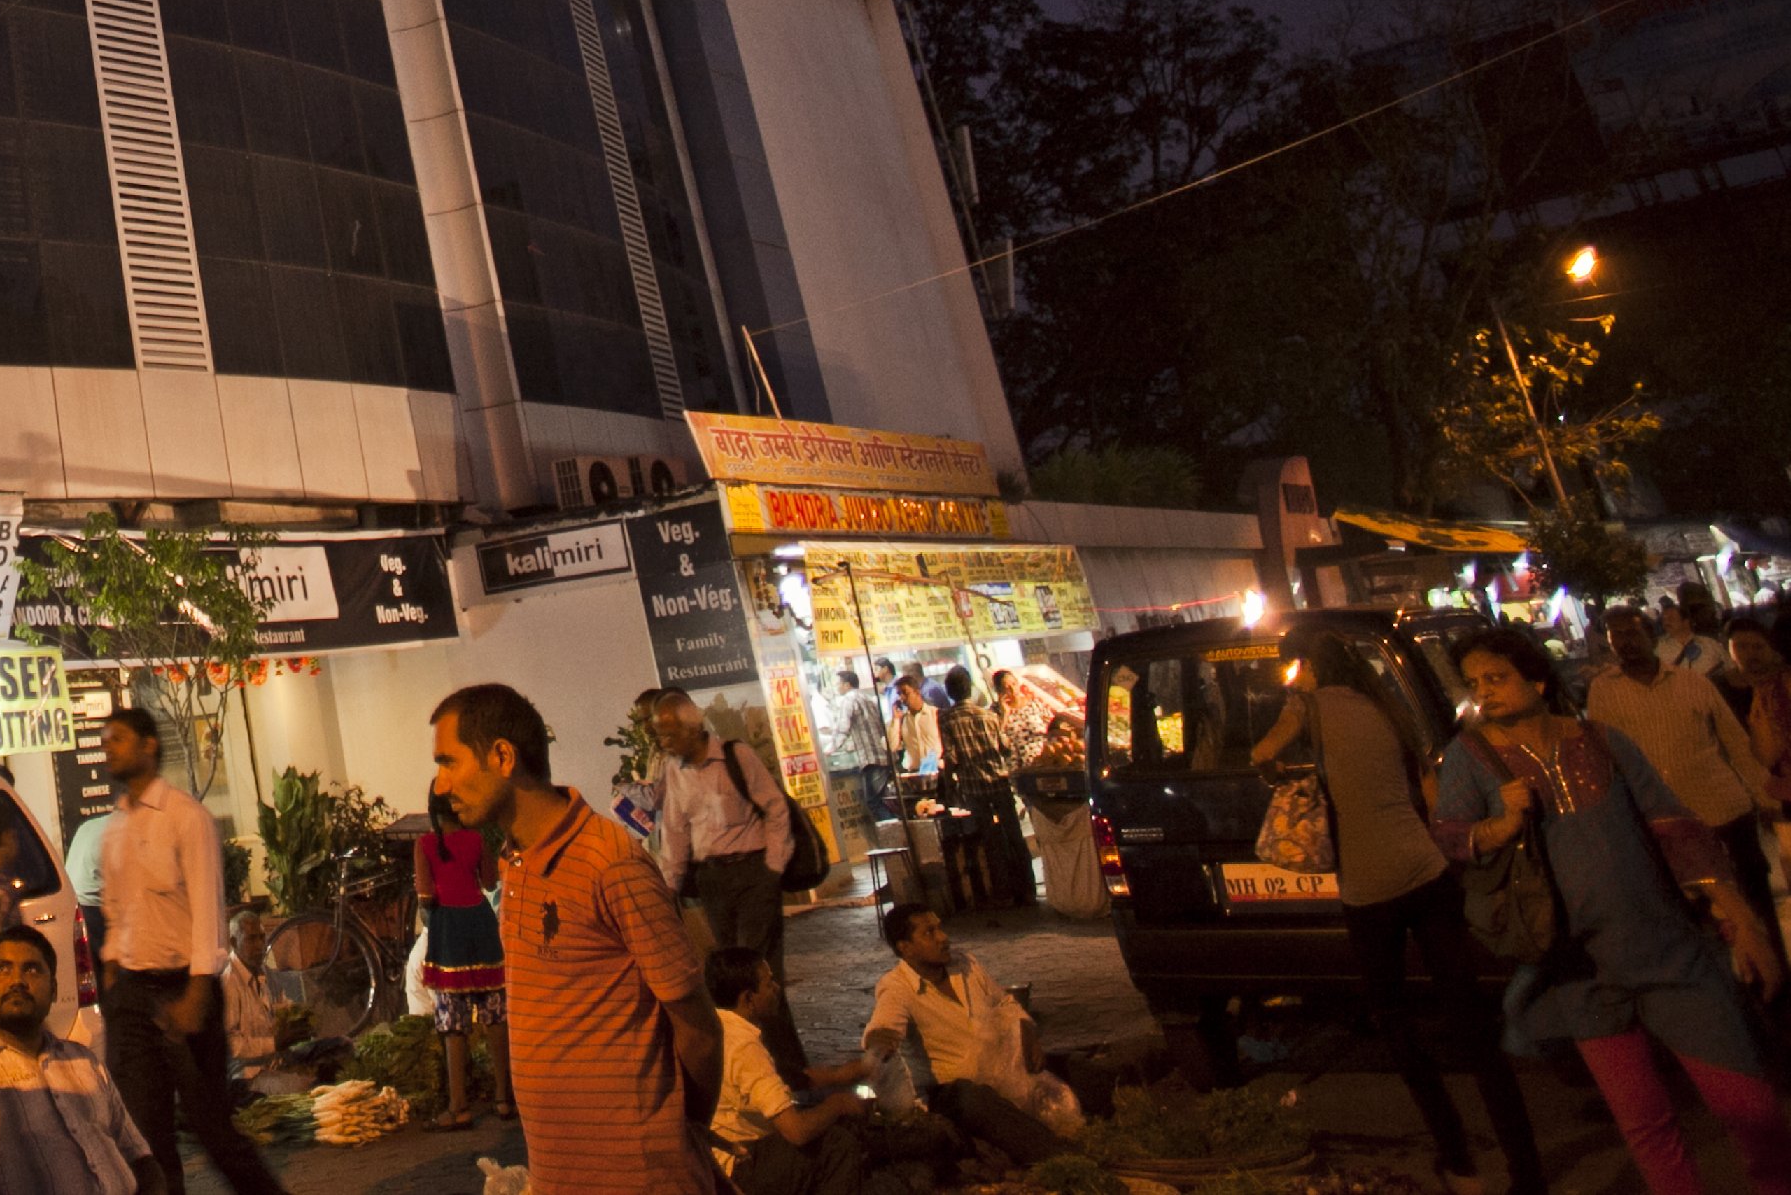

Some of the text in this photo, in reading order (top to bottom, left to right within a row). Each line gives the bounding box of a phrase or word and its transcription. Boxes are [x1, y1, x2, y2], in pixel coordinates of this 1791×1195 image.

[766, 490, 839, 529] BANDRA
[839, 494, 893, 532] JUMBO
[657, 520, 701, 545] Veg.
[380, 553, 407, 575] Veg.
[506, 538, 604, 577] kalimiri
[679, 553, 695, 577] &
[392, 578, 403, 597] &
[375, 604, 429, 624] Non-Veg.
[651, 585, 739, 619] Non-Veg.
[676, 633, 728, 653] Family
[667, 654, 750, 681] Restaurant
[1226, 876, 1324, 897] MH 02 CP
